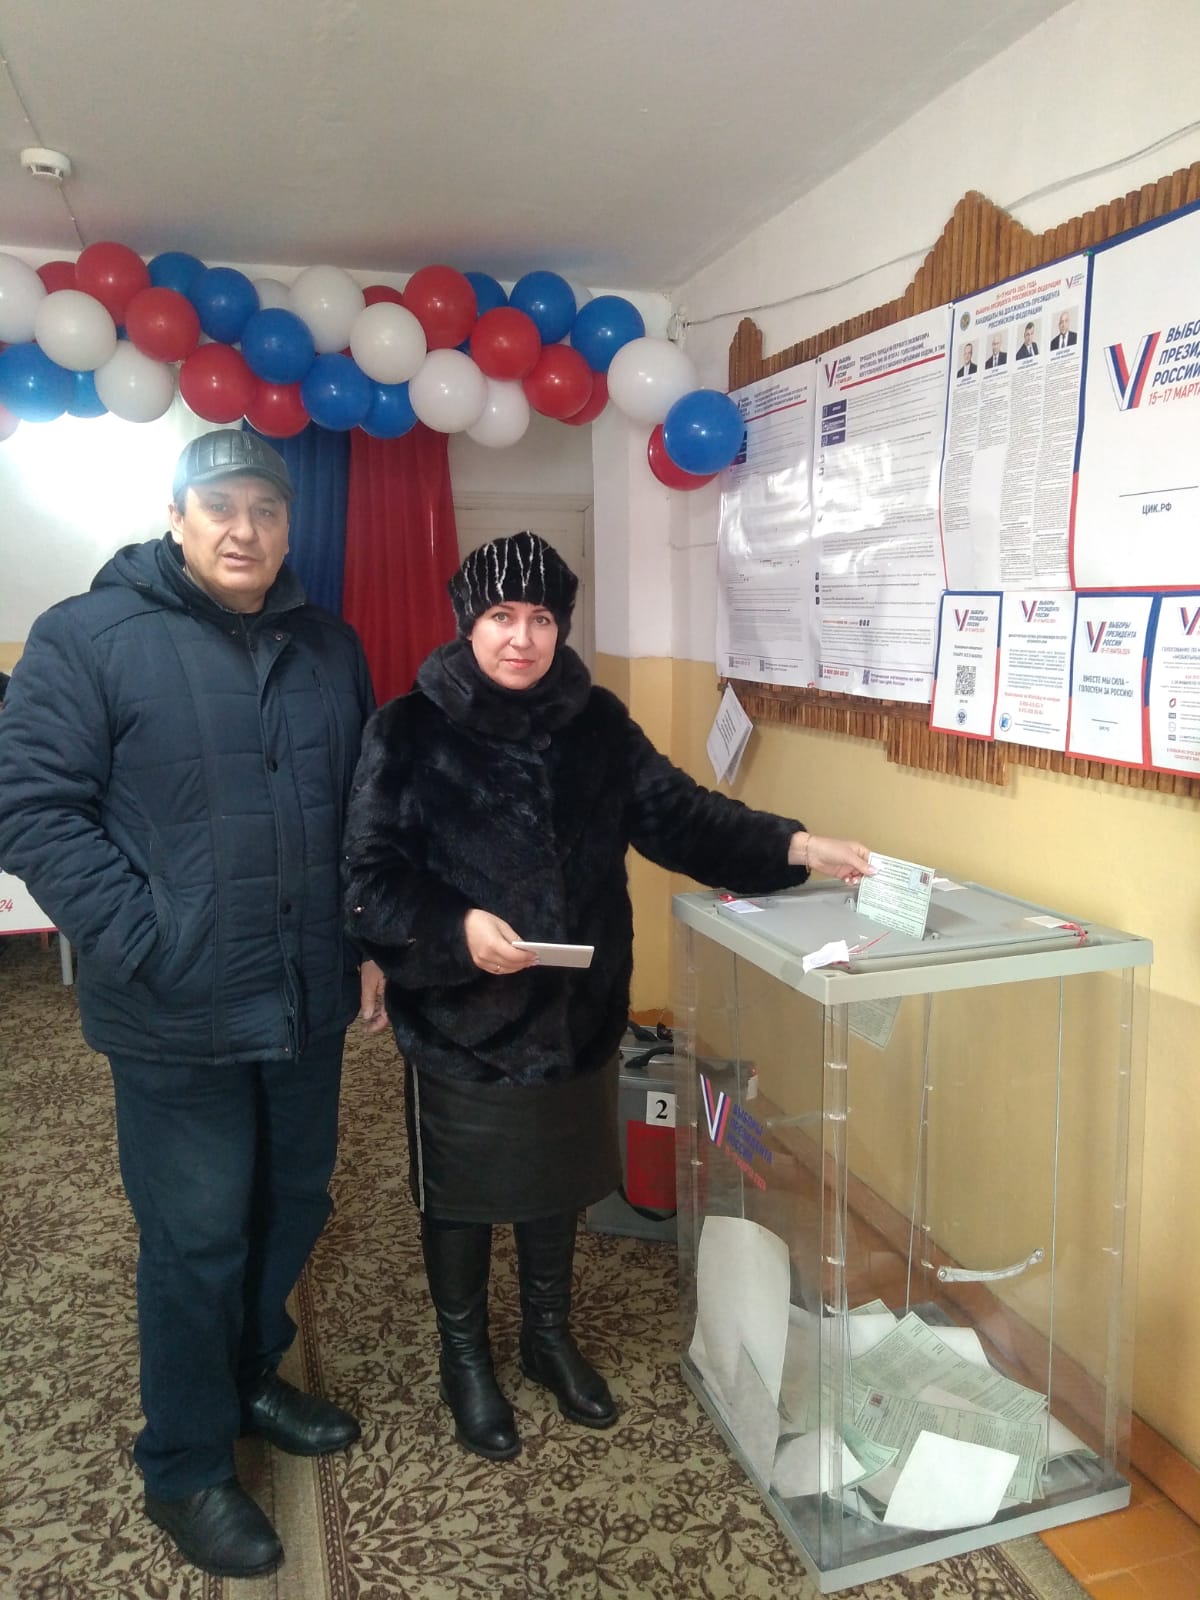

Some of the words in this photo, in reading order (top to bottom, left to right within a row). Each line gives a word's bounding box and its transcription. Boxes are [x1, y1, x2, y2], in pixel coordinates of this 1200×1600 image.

[1142, 502, 1172, 516] ЦИК.РФ
[1082, 674, 1101, 684] ВМЕСТЕ
[1079, 684, 1103, 694] ГОЛОСУЕМ
[656, 1099, 668, 1120] 2
